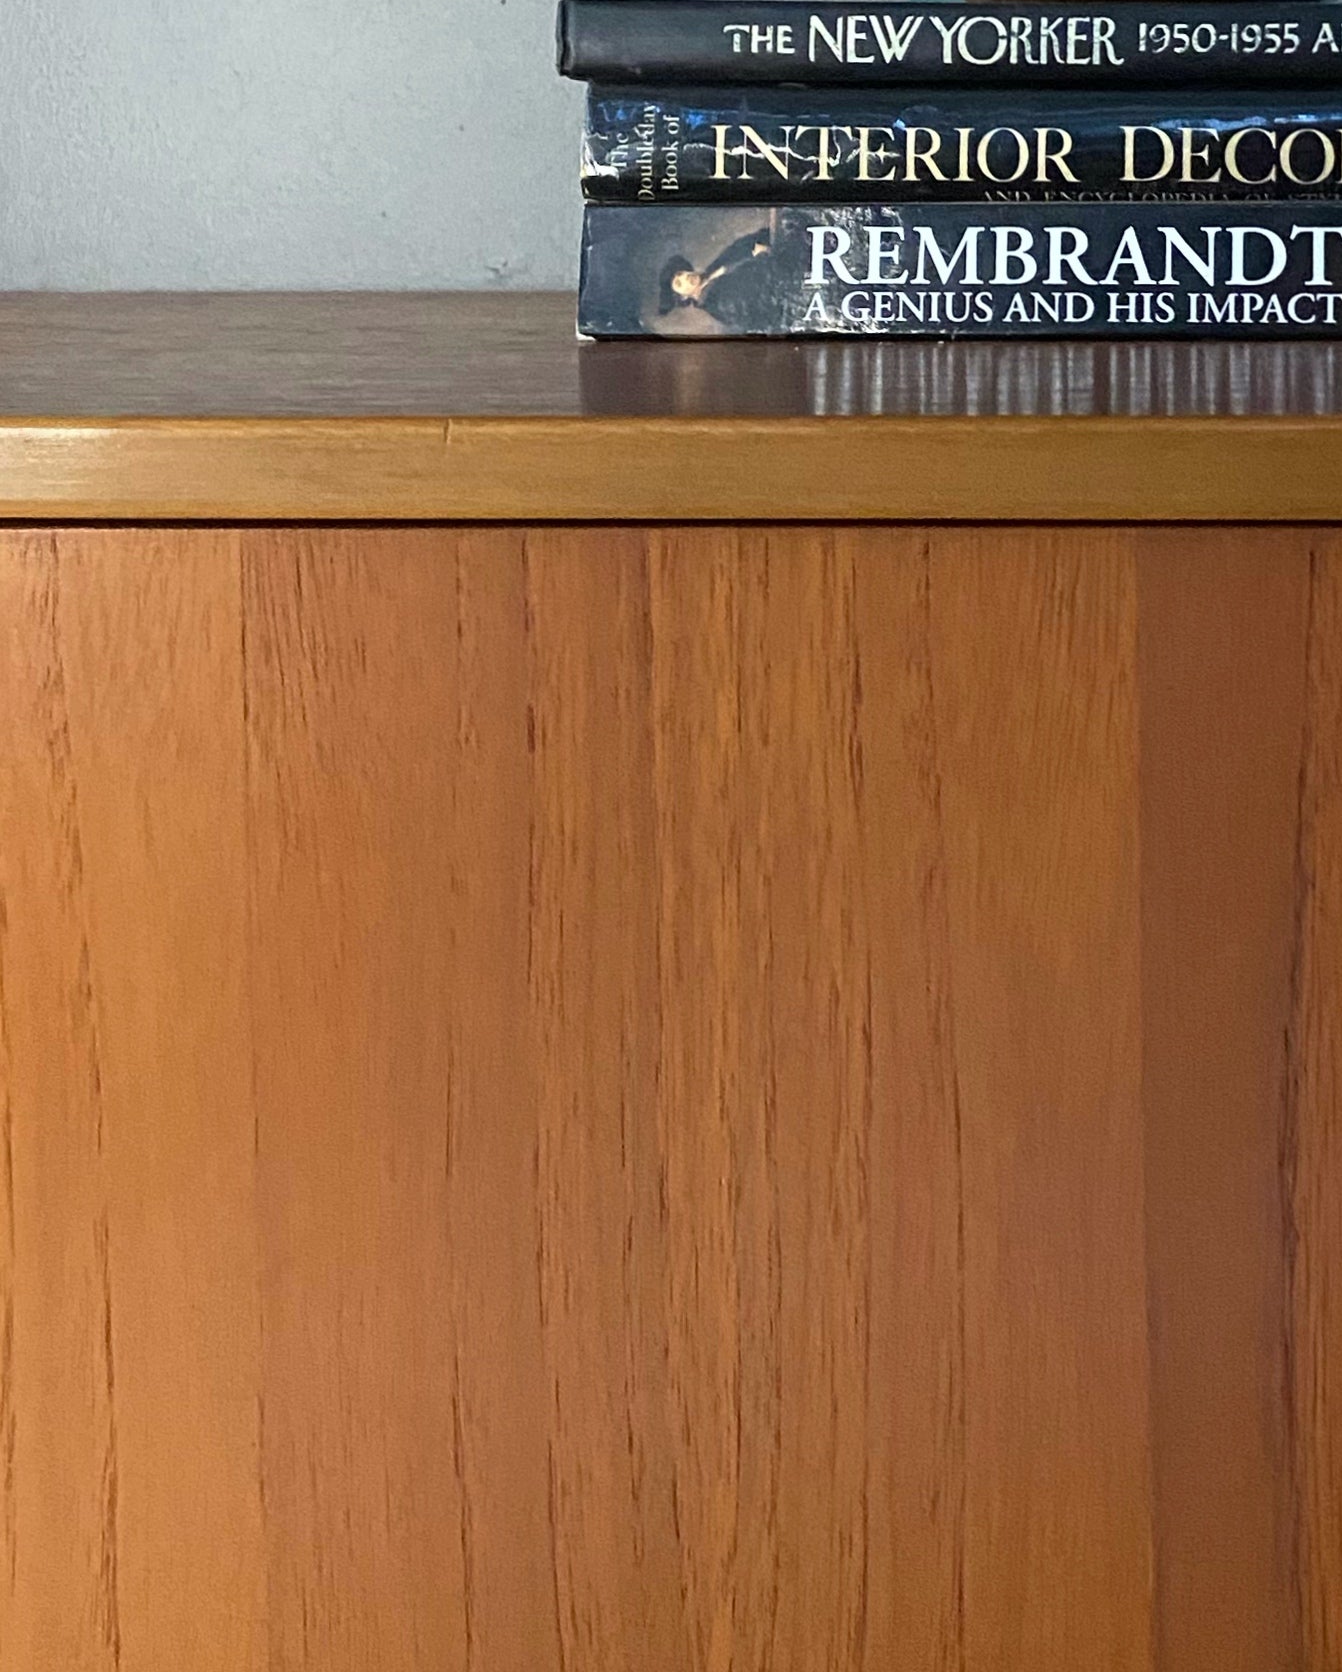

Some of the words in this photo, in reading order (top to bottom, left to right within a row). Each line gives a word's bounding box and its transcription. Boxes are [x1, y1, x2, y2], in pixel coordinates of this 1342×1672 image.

[723, 23, 796, 54] THE
[808, 14, 924, 64] NEW
[928, 15, 1125, 67] YORKER
[1138, 21, 1301, 55] 1950-1955
[662, 114, 680, 135] of
[660, 140, 680, 190] Book
[709, 124, 1081, 183] INTERIOR
[802, 293, 826, 322] A
[841, 291, 994, 323] GENIUS
[1002, 292, 1095, 324] AND
[1106, 292, 1176, 324] HIS
